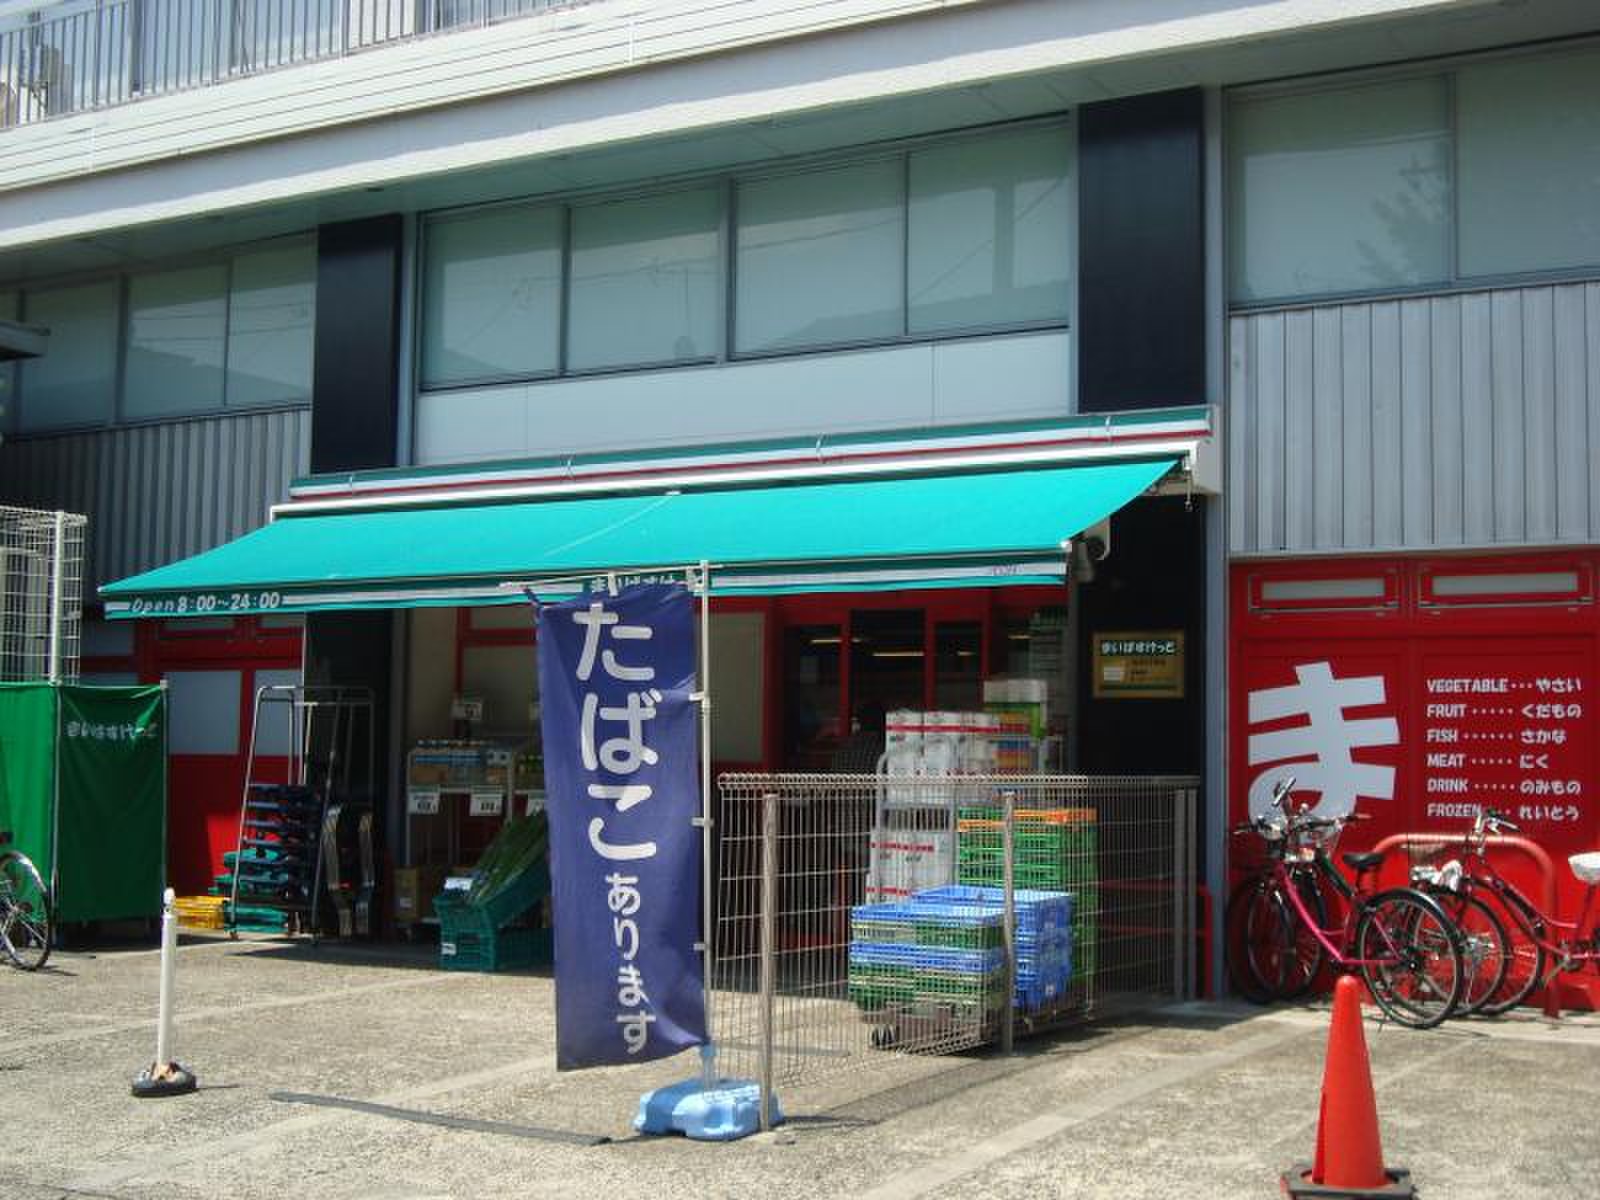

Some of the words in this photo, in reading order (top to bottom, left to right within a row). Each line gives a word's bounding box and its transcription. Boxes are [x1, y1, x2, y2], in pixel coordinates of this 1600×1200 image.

[131, 597, 175, 614] Open
[1427, 678, 1509, 693] VEGETABLE
[1535, 677, 1582, 693] やさい
[1426, 704, 1467, 718] FRUIT
[1521, 704, 1582, 718] くだもの
[572, 602, 662, 861] たばこ
[1426, 728, 1459, 743] FISH
[1520, 728, 1567, 744] さかな
[1248, 661, 1400, 824] ま
[1426, 753, 1466, 768] MEAT
[1519, 754, 1549, 769] にく
[1427, 778, 1469, 792] DRINK
[1519, 779, 1582, 795] のみもの
[1427, 803, 1483, 817] FROZEN
[1519, 805, 1580, 821] れいとう
[605, 872, 657, 1053] あります
